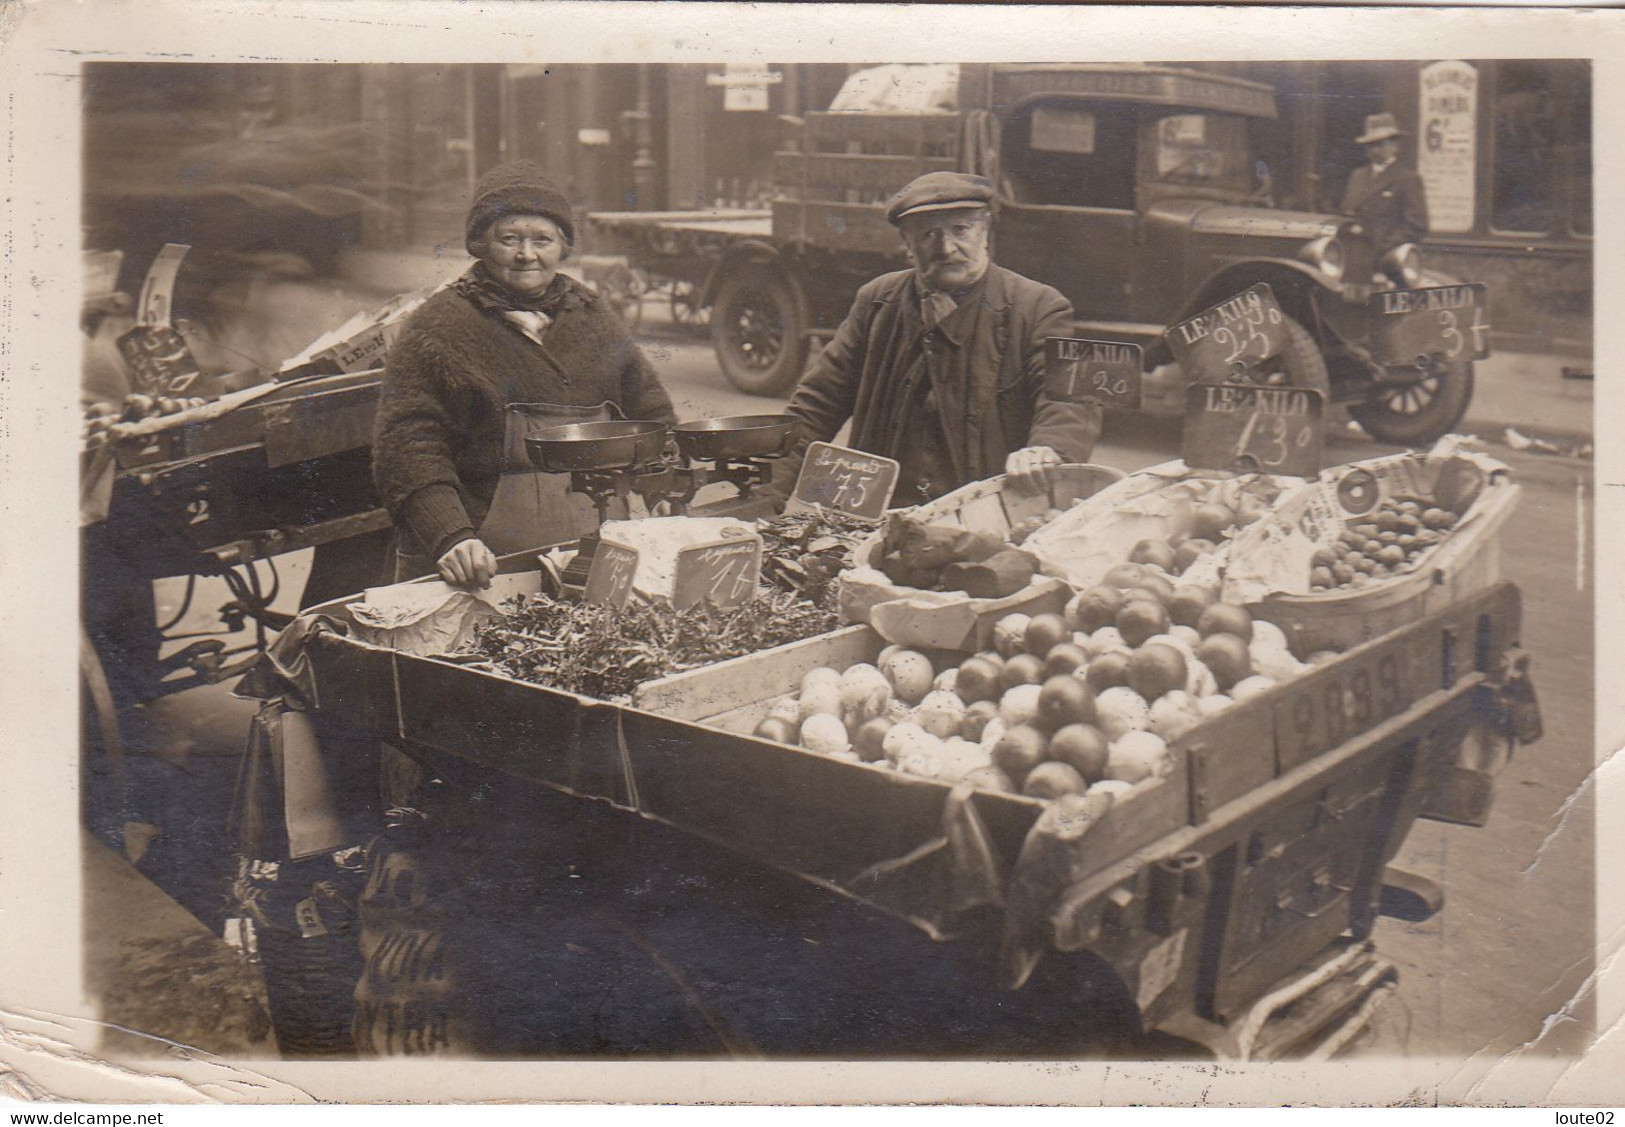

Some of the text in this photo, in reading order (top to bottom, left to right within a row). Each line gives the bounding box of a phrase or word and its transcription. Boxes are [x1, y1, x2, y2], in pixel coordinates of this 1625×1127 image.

[1383, 291, 1411, 314] LE
[1427, 286, 1474, 311] KILO
[1179, 315, 1209, 345] LE
[1216, 290, 1260, 325] KILO
[1057, 340, 1080, 360] LE
[1093, 343, 1132, 363] KILO
[1205, 387, 1236, 413] LE
[1256, 389, 1308, 417] KILO
[831, 471, 874, 508] 75
[187, 499, 210, 525] 2
